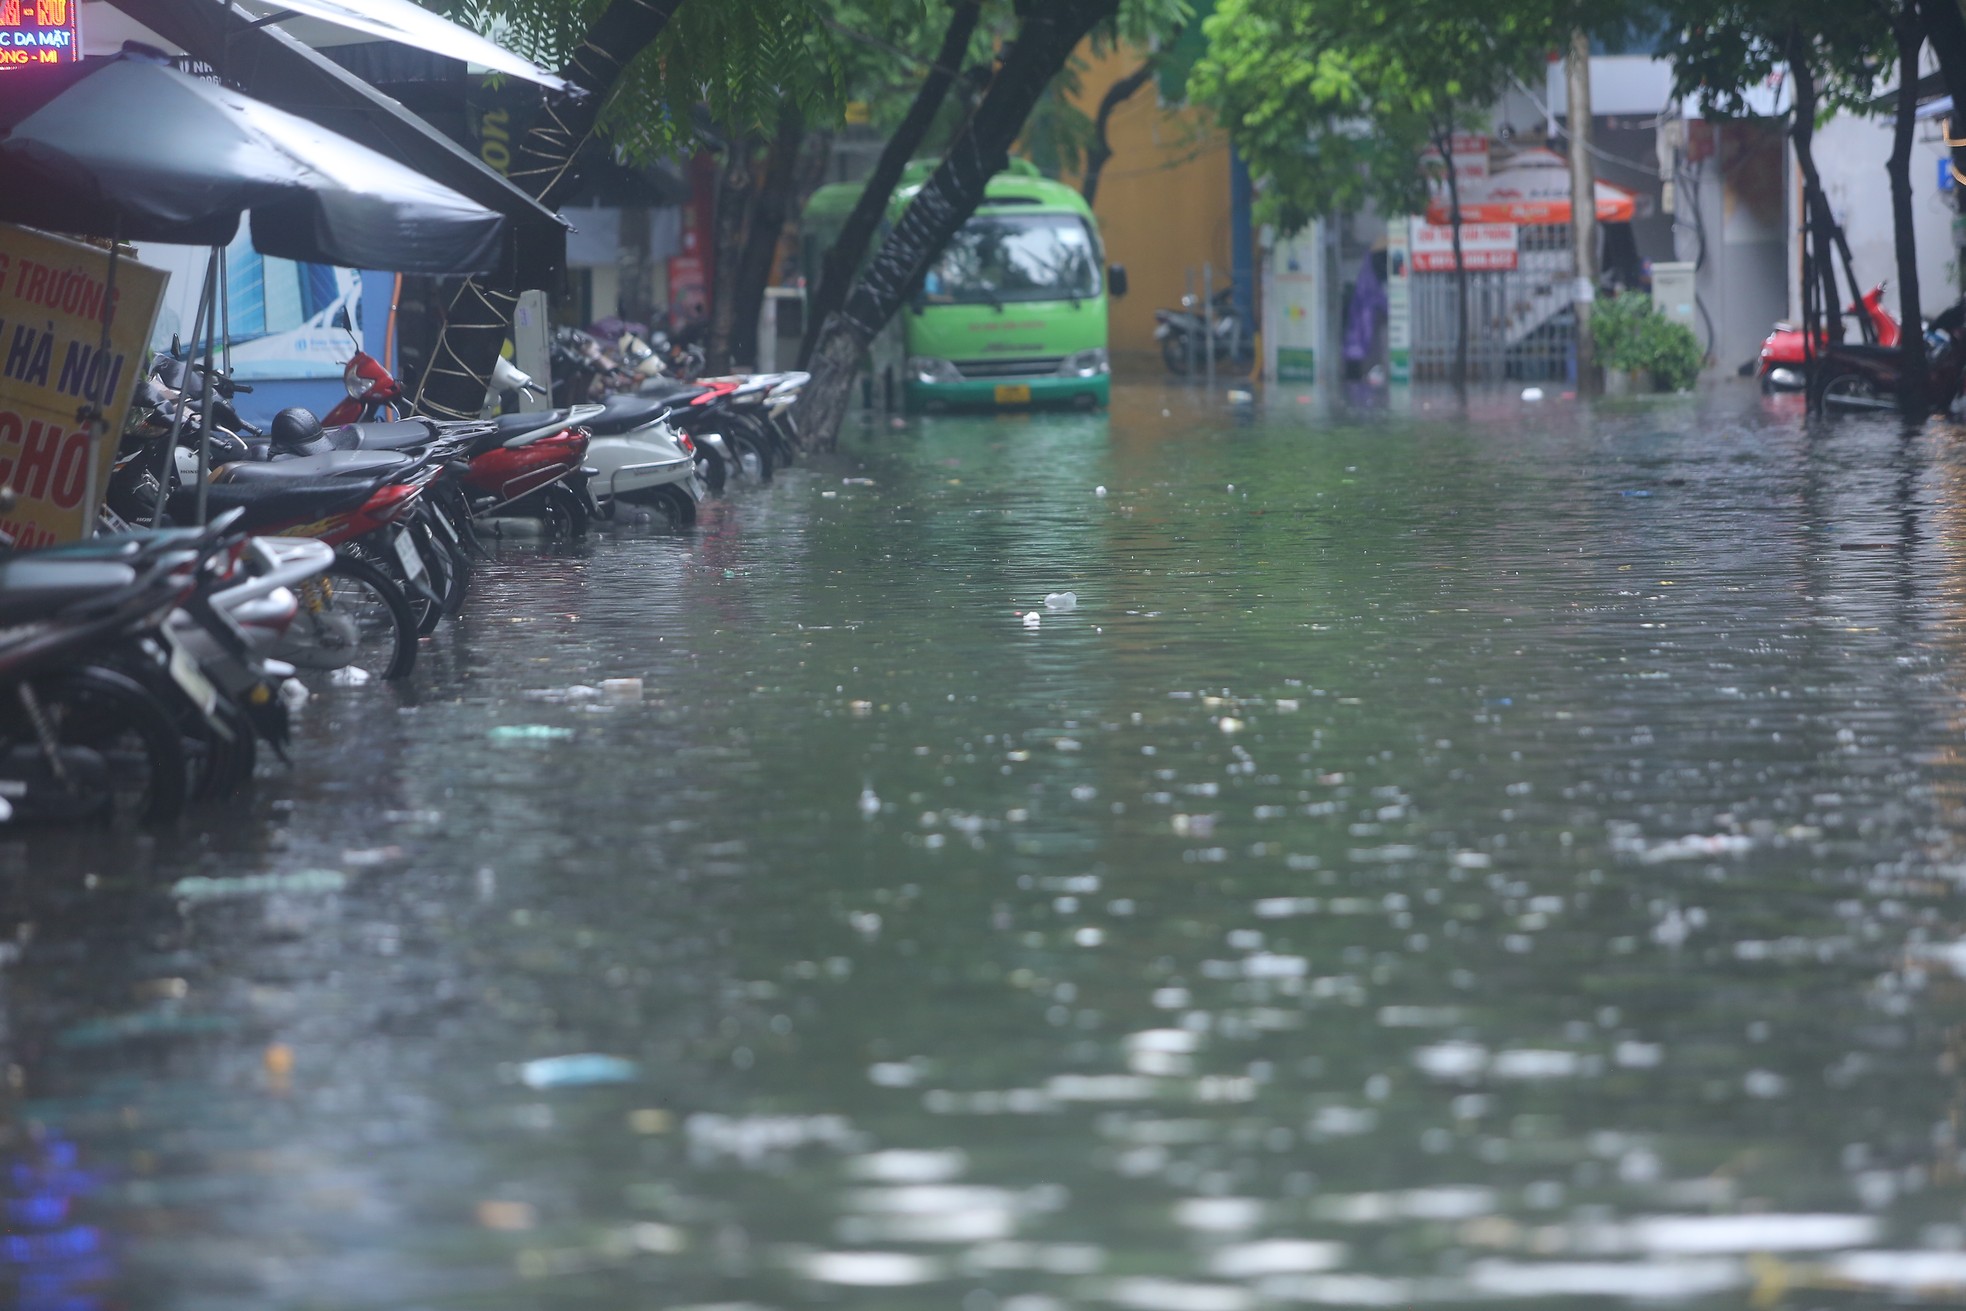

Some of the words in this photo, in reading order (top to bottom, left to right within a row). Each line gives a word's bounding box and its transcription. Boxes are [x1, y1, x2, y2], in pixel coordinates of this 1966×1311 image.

[14, 32, 37, 46] DA
[38, 29, 71, 48] MẶT
[40, 49, 58, 63] MI
